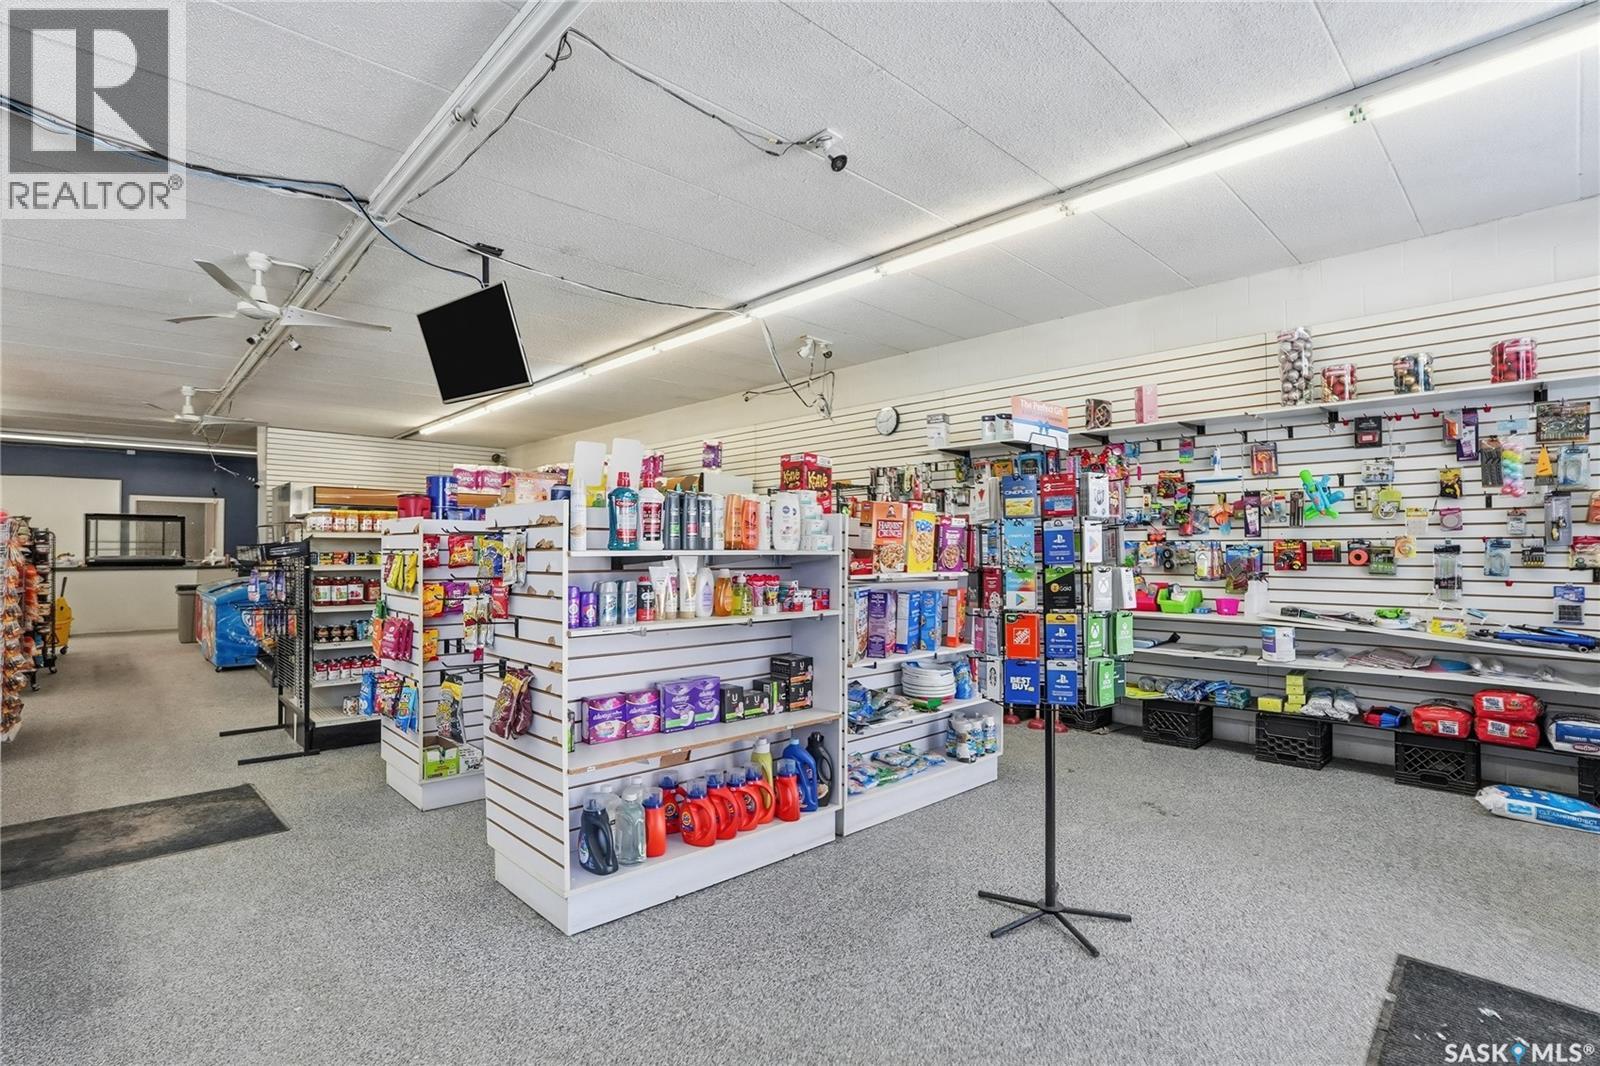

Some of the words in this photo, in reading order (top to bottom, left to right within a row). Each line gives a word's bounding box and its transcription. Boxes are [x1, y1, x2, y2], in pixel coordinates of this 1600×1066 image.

[1020, 399, 1032, 409] The
[1033, 401, 1054, 415] Perfect
[1054, 405, 1063, 417] Gift
[807, 471, 828, 489] Krave
[878, 520, 904, 530] HARVEST
[877, 529, 903, 538] CRUNCH
[1060, 583, 1072, 592] Gold
[1010, 676, 1032, 684] BEST
[1011, 683, 1029, 691] BUY
